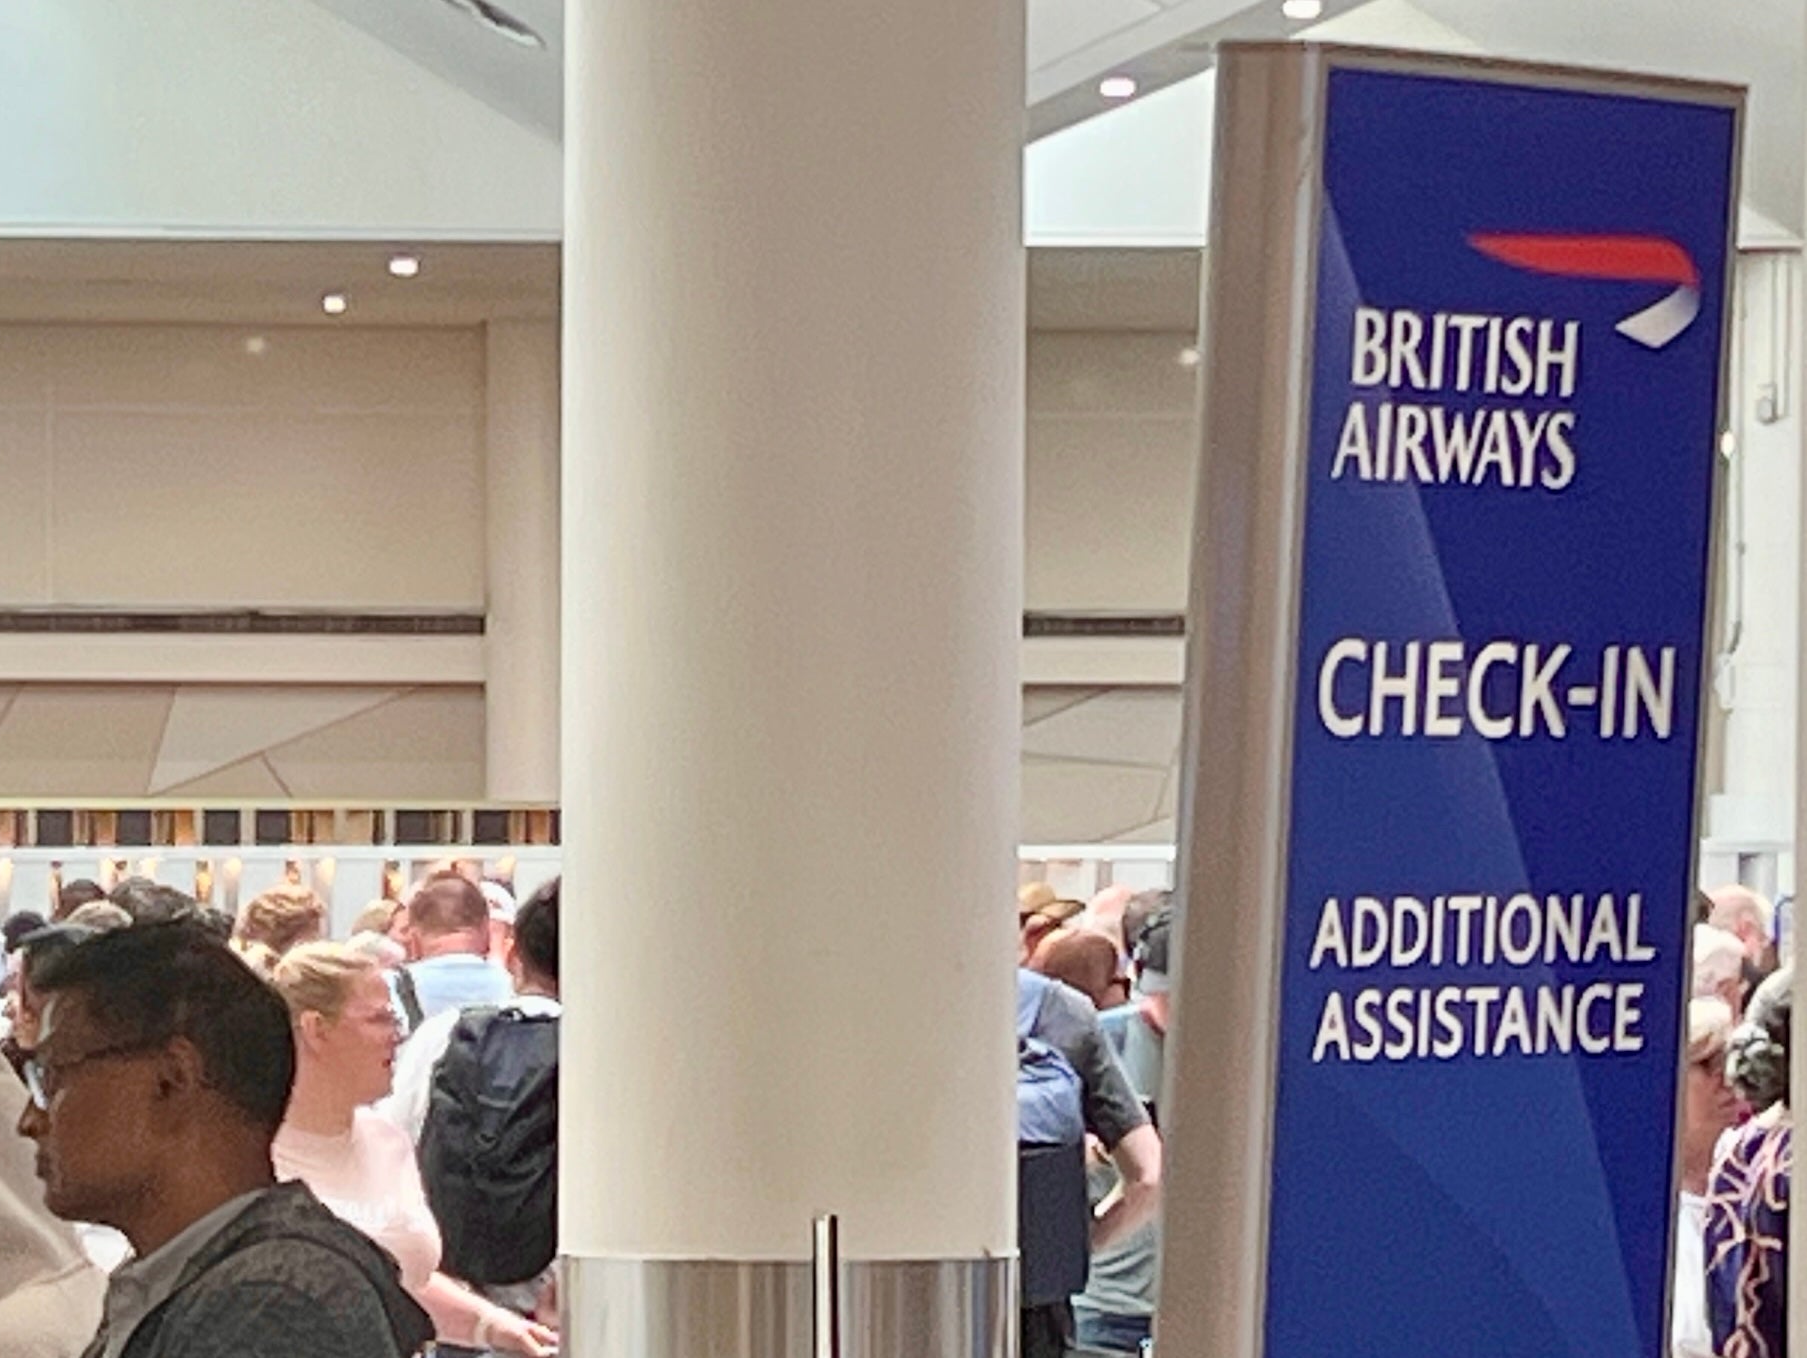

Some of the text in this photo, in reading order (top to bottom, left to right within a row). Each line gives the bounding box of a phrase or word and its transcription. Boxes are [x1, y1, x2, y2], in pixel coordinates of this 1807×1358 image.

[1351, 307, 1580, 397] BRITISH
[1330, 404, 1577, 491] AIRWAYS
[1318, 638, 1677, 740] CHECK-IN
[1309, 893, 1656, 970] ADDITIONAL
[1312, 983, 1645, 1063] ASSISTANCE
